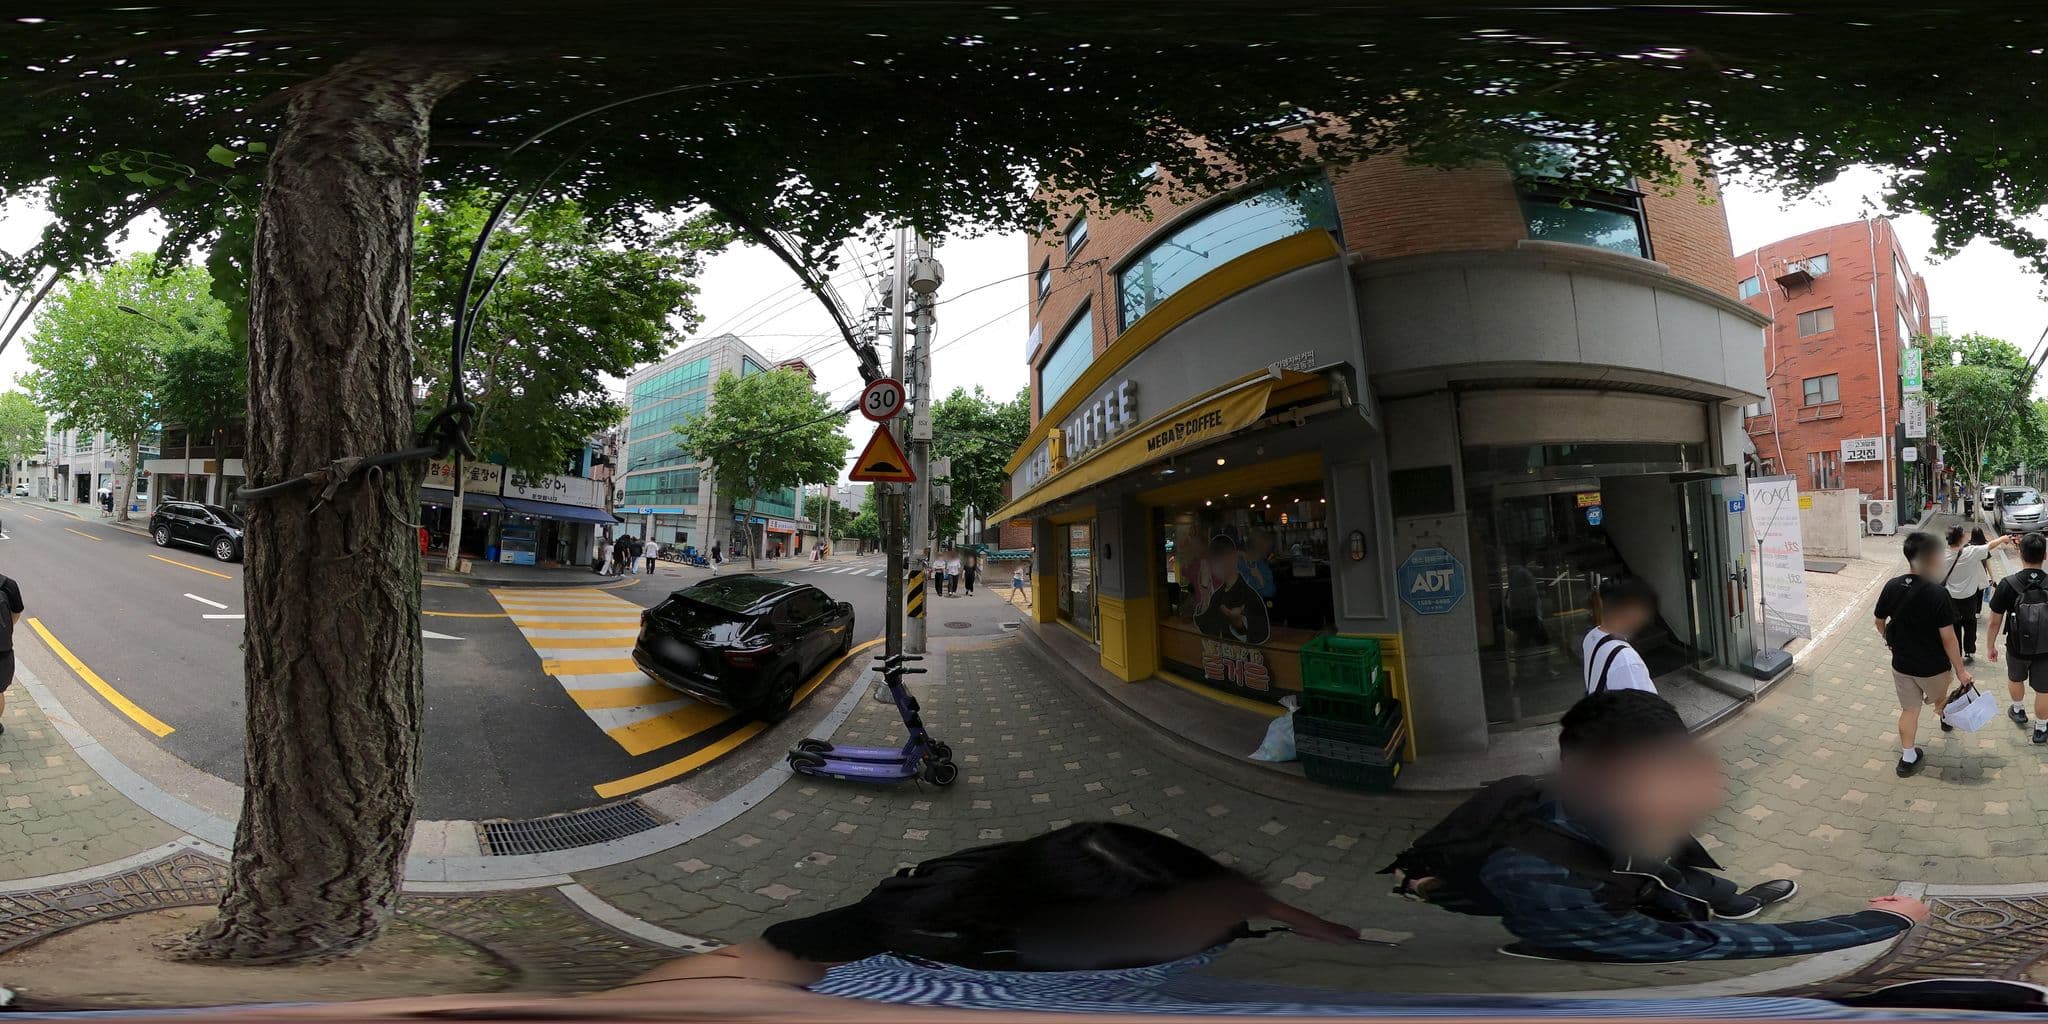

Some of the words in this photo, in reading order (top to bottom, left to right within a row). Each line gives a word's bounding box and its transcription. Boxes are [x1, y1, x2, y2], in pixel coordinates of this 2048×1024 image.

[869, 389, 895, 410] 30
[1025, 445, 1050, 486] MEGA
[1066, 378, 1135, 458] COFFEE
[1147, 429, 1175, 452] MEGA
[1186, 409, 1222, 436] COFFEE
[1847, 448, 1876, 461] 고깃집
[1410, 569, 1454, 593] ADT
